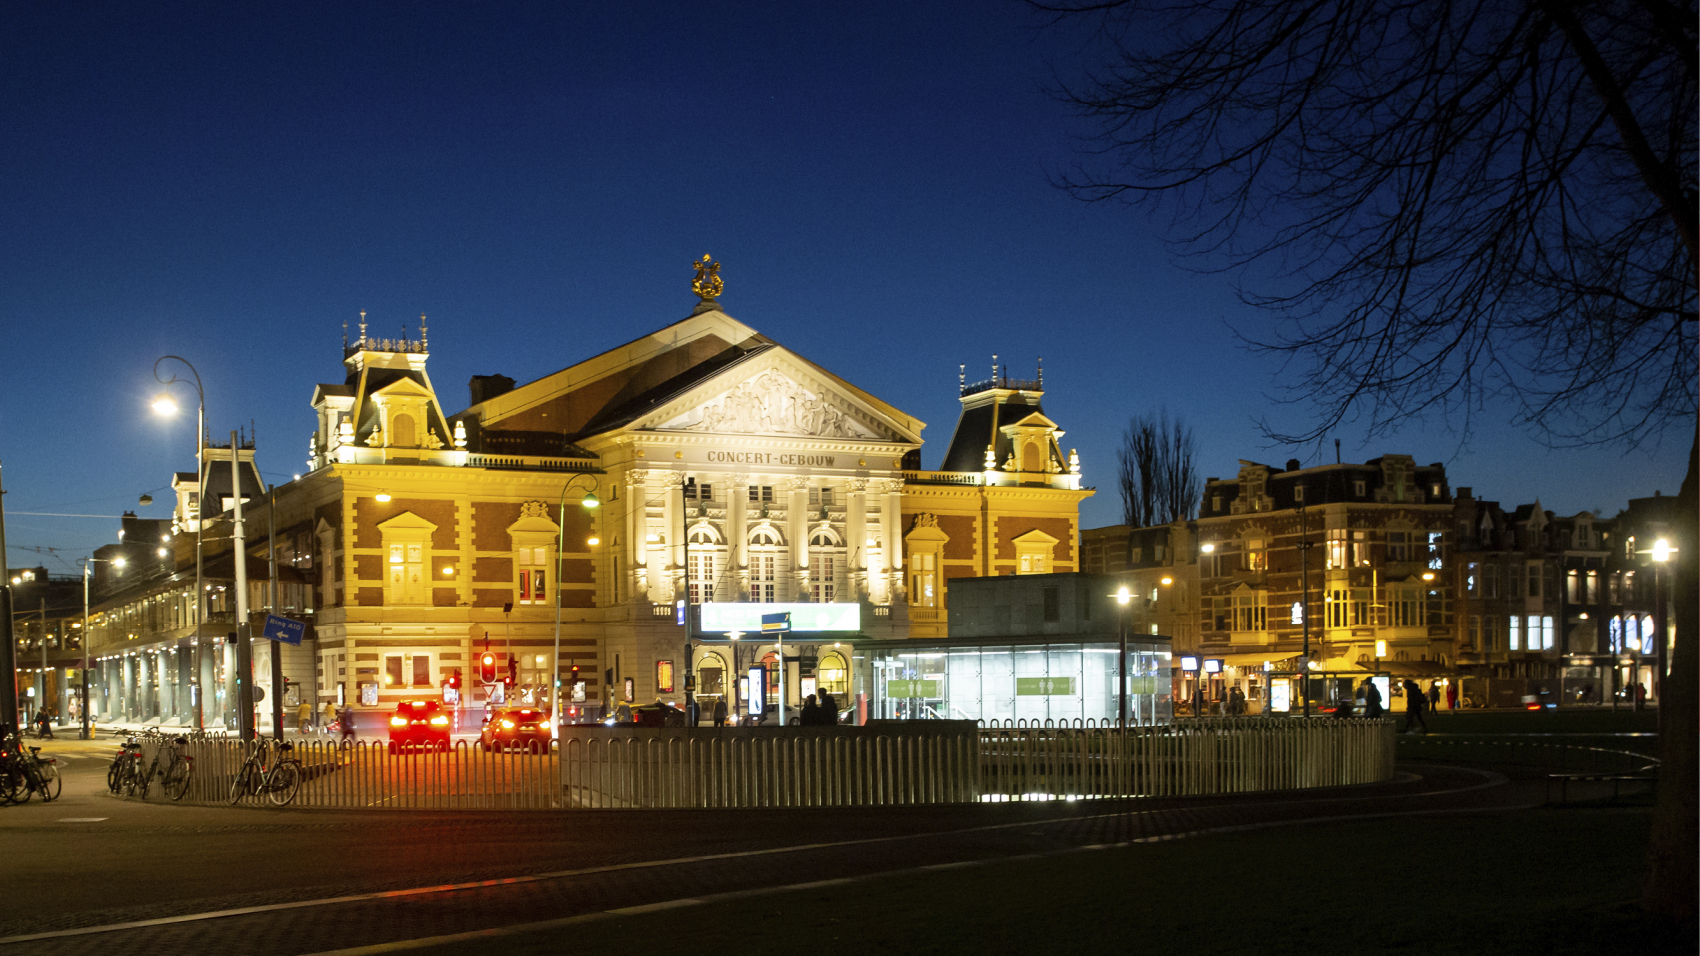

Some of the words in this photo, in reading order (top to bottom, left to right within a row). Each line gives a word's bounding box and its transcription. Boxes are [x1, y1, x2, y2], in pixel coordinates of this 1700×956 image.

[707, 450, 836, 467] CONCERT-GEBOUW
[269, 618, 286, 628] Ring
[288, 623, 301, 631] A10
